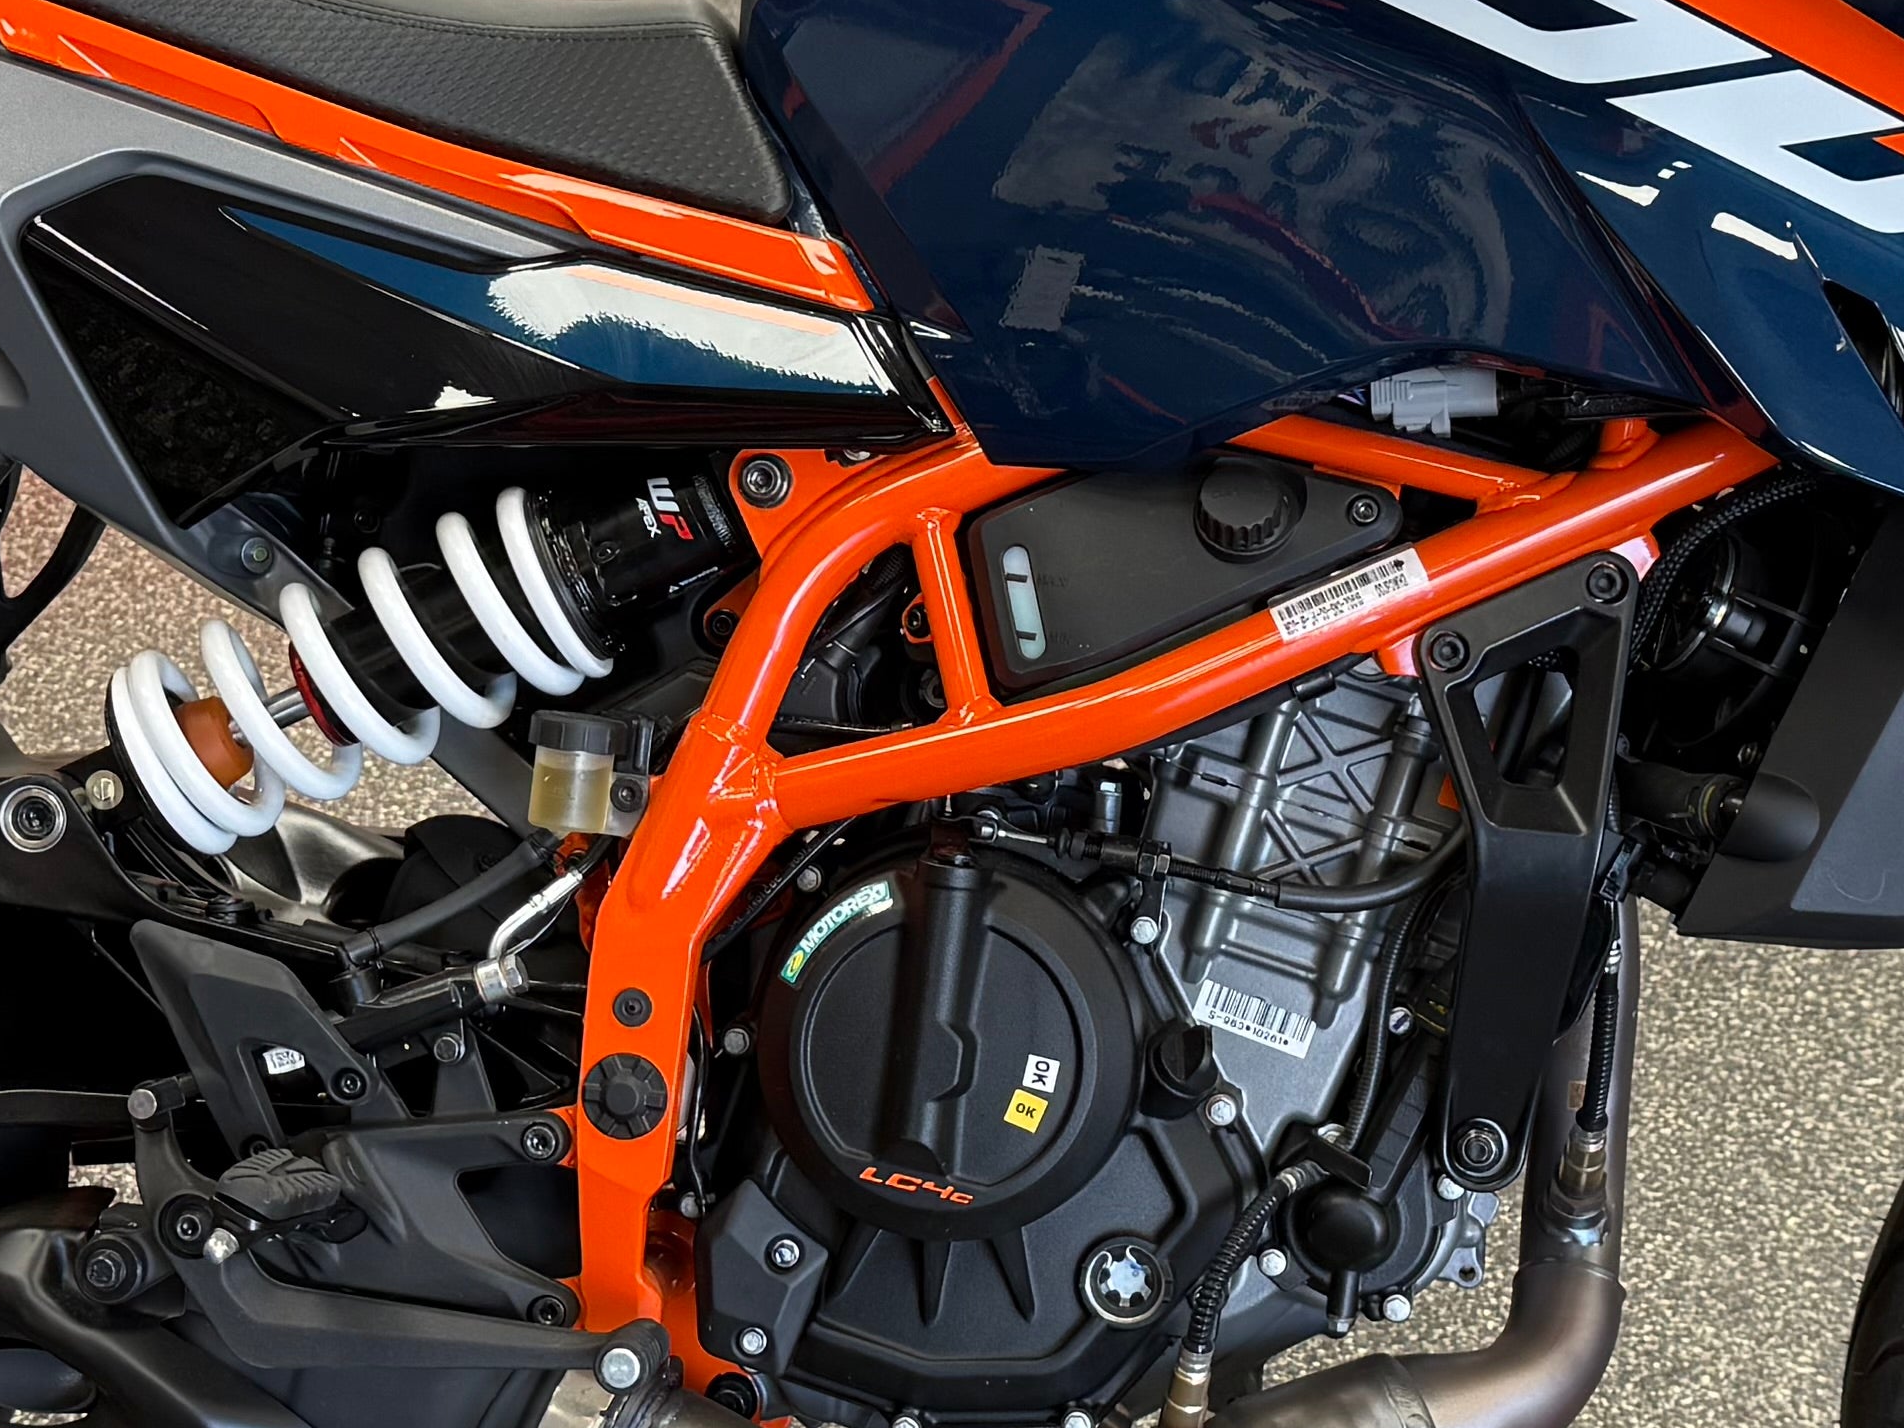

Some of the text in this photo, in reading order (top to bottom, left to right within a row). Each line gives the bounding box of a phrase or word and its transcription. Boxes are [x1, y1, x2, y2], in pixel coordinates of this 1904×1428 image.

[635, 497, 662, 539] APEX
[646, 477, 695, 540] WP
[799, 883, 888, 953] MOTOREX
[1032, 1060, 1050, 1087] OK
[1015, 1102, 1037, 1119] OK
